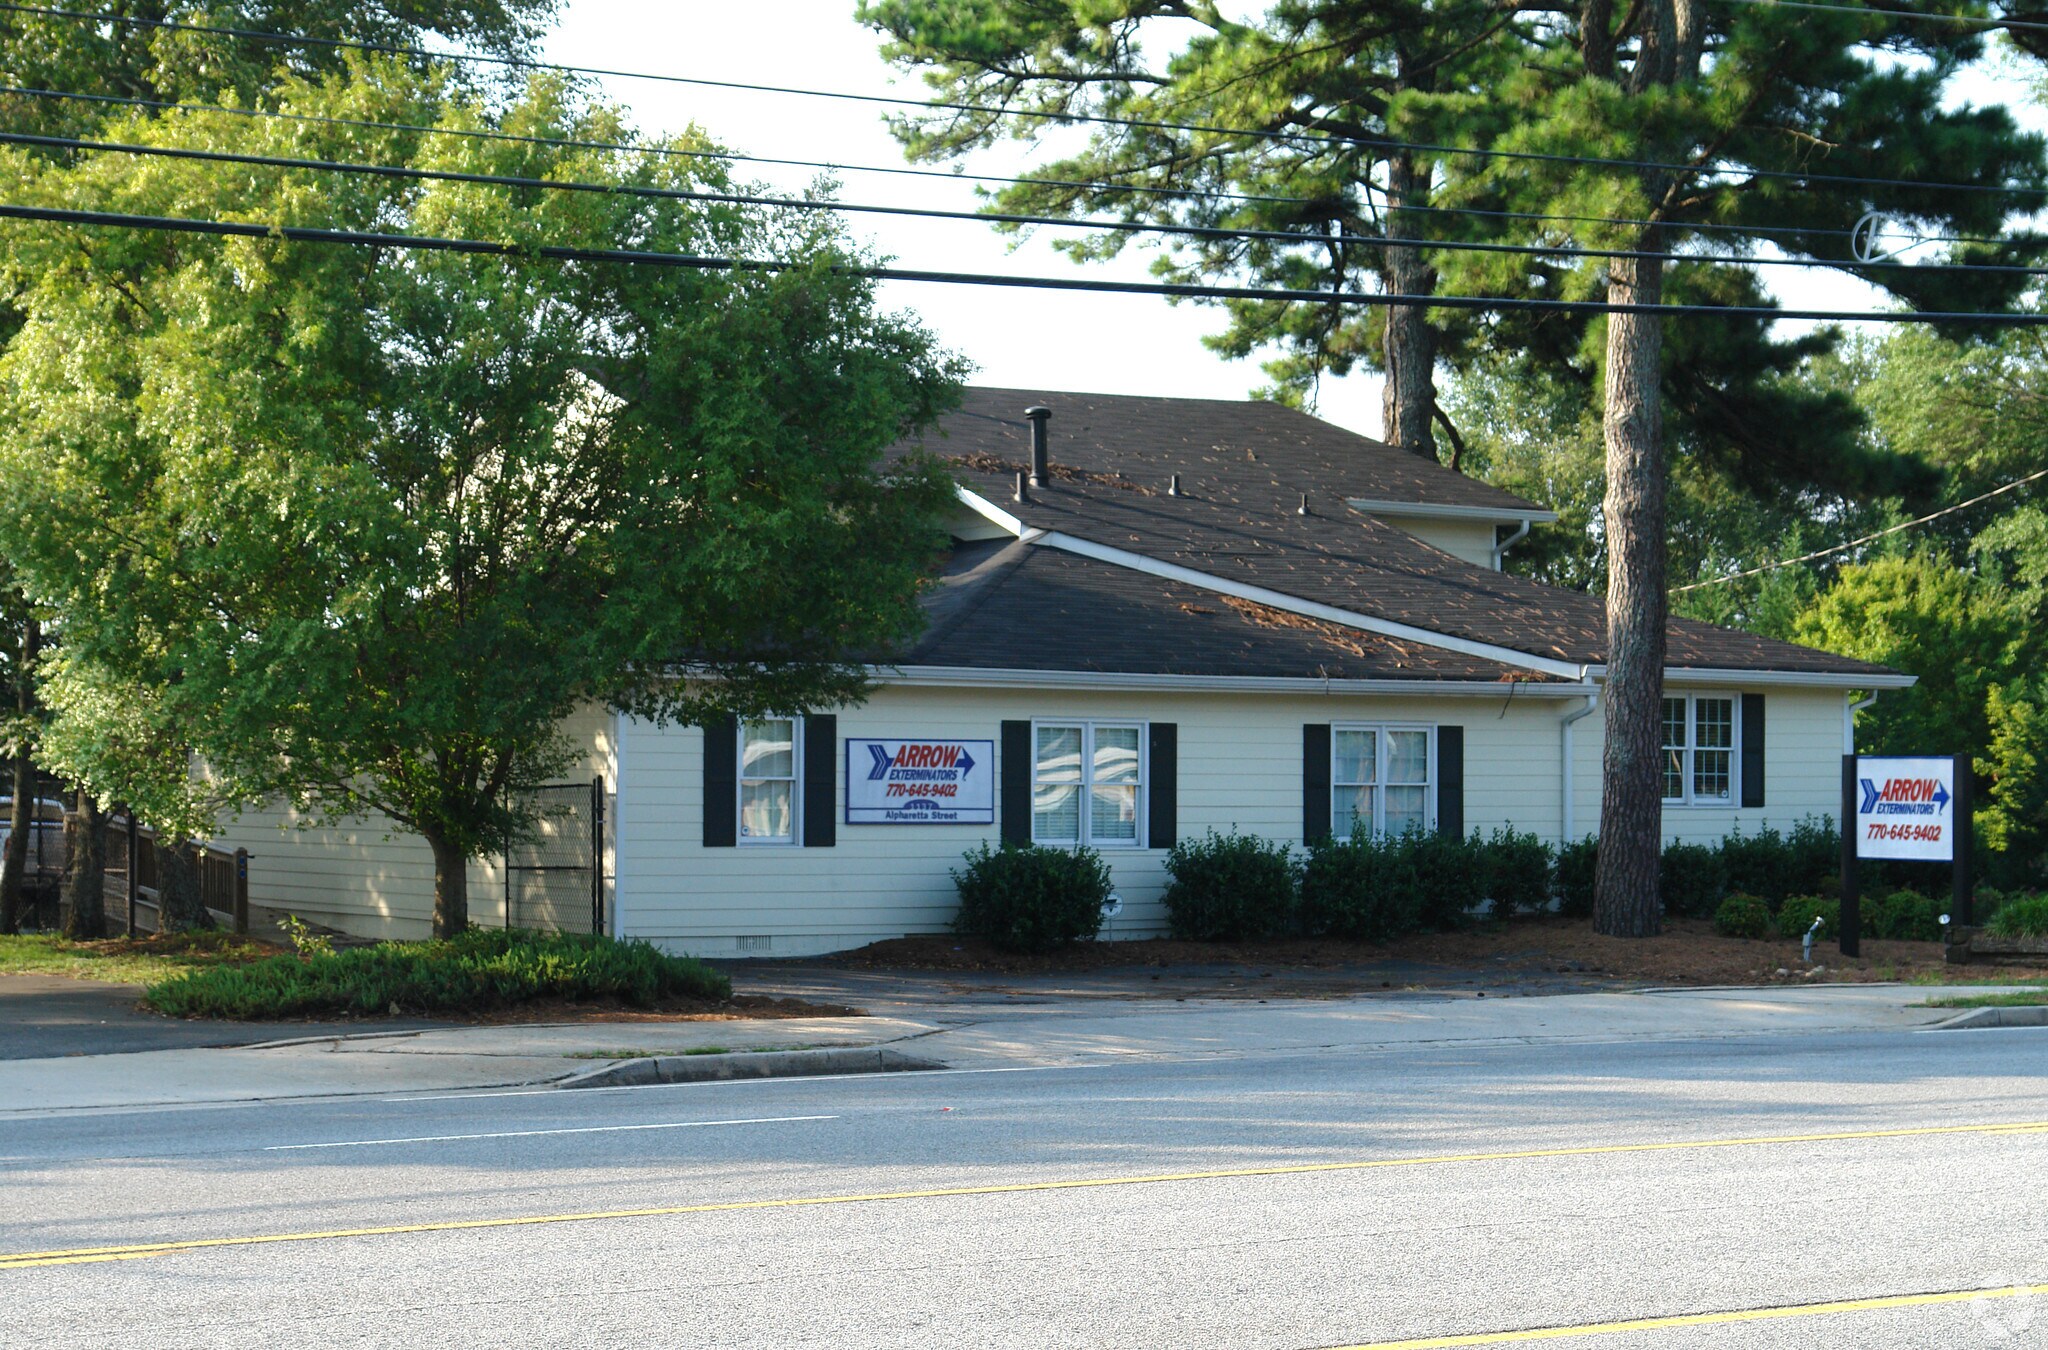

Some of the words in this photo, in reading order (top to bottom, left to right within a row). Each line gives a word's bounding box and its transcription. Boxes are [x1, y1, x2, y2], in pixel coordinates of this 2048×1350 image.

[893, 745, 961, 768] ARROW
[889, 769, 958, 781] EXTERMINATORS
[887, 783, 958, 797] 770-645-9402
[1880, 778, 1938, 802] ARROW
[886, 810, 928, 820] Alpharetta
[931, 811, 958, 820] Street
[1877, 803, 1935, 815] EXTERMINATORS
[1867, 824, 1942, 841] 770-645-9402
